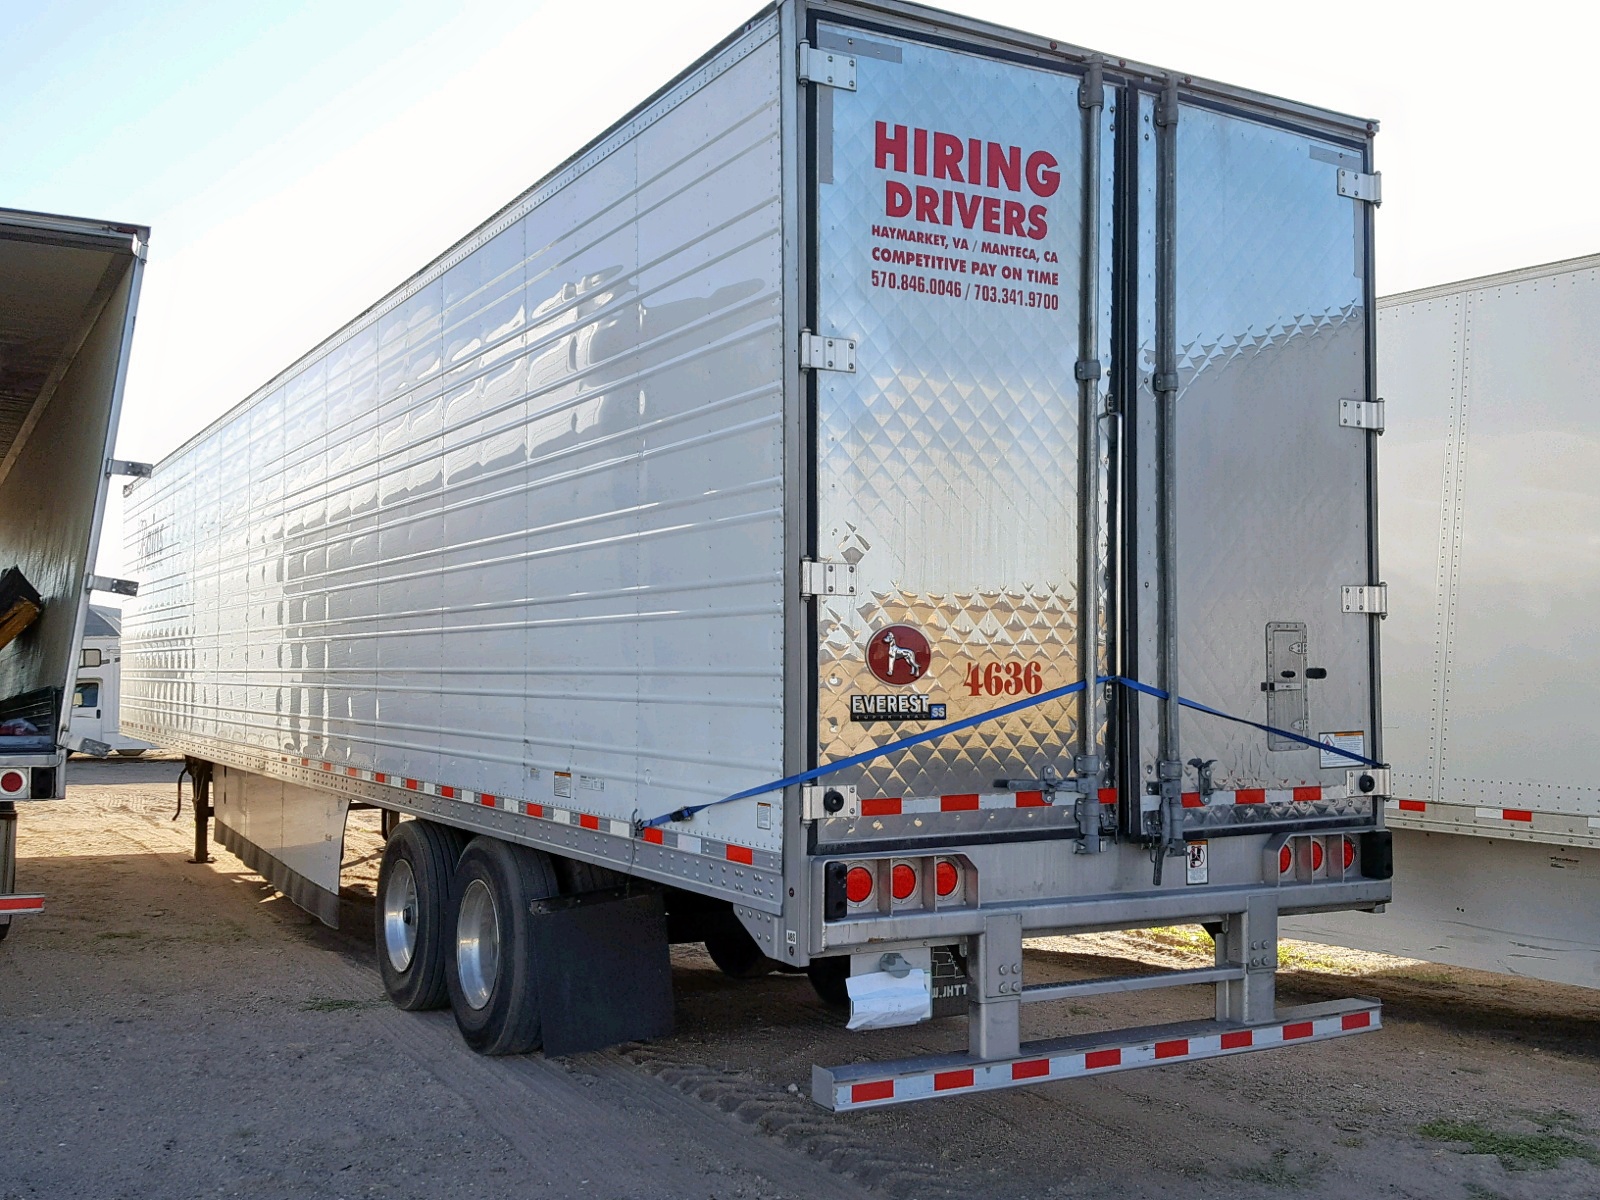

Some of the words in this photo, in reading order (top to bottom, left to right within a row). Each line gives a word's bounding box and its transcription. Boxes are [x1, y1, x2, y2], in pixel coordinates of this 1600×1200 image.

[874, 120, 1061, 198] HIRING
[885, 180, 1048, 241] DRIVERS
[871, 224, 949, 250] HAYMARKET,
[952, 237, 969, 251] VA
[981, 241, 1040, 263] MANTECA,
[1043, 250, 1059, 264] CA
[871, 247, 967, 273] COMPETITIVE
[971, 262, 997, 278] PAY
[1001, 265, 1022, 281] ON
[1026, 269, 1059, 286] TIME
[871, 269, 962, 298] 570.846.0046
[974, 284, 1059, 310] 703.341.9700
[962, 660, 1043, 697] 4636
[852, 695, 929, 714] EVEREST
[931, 707, 945, 718] SS
